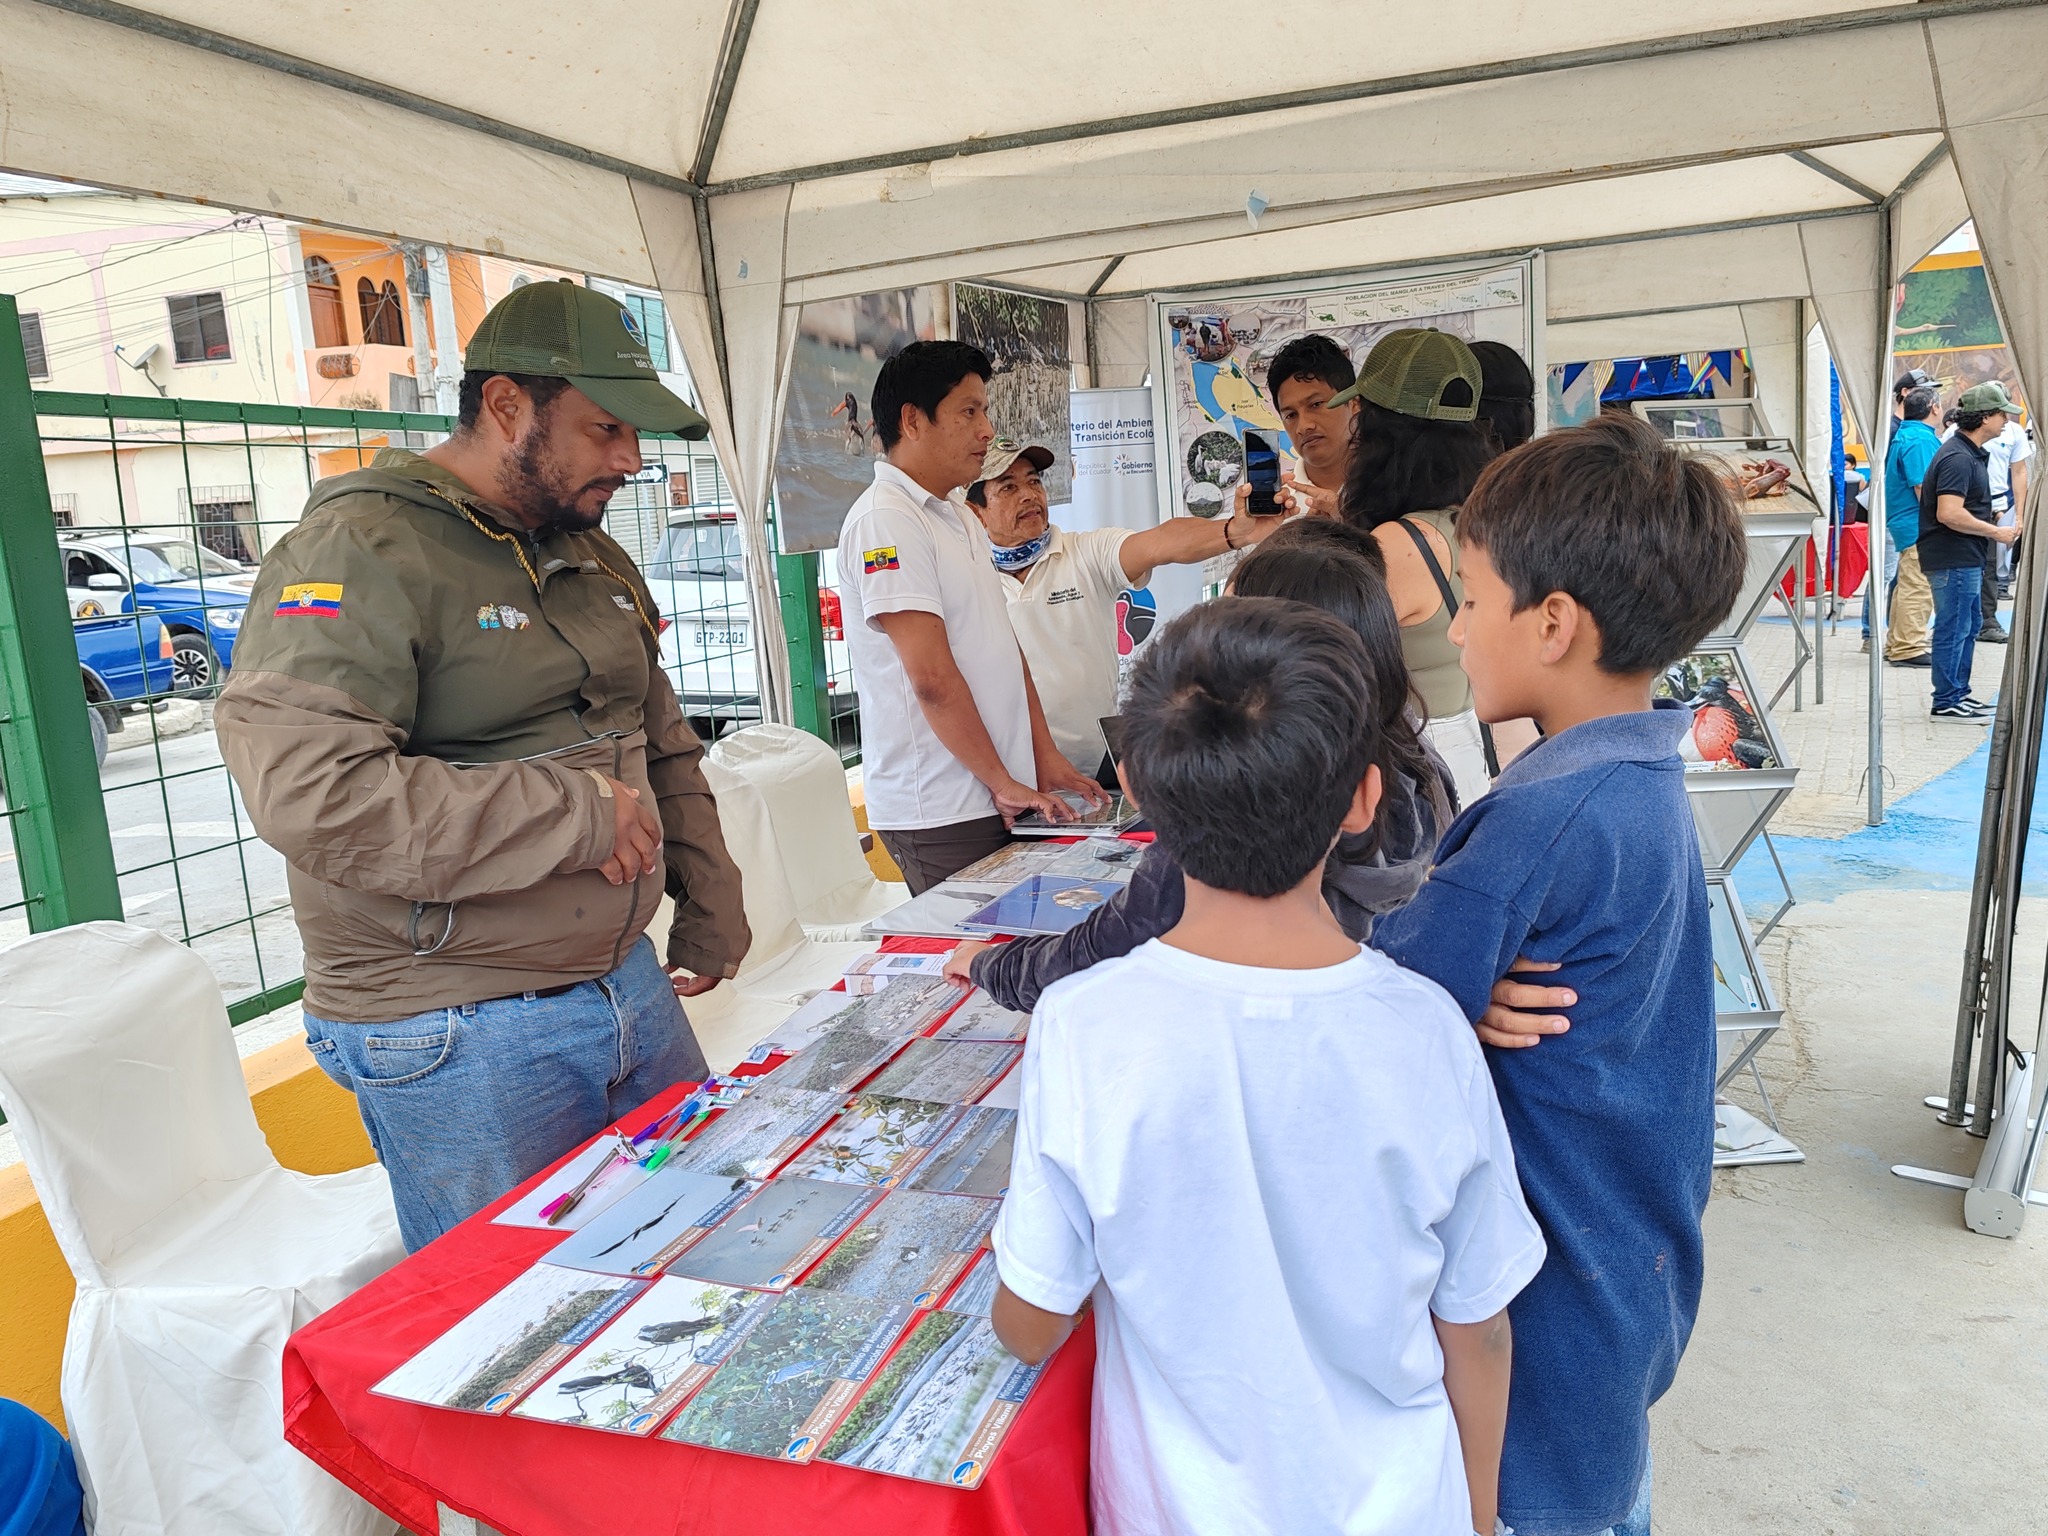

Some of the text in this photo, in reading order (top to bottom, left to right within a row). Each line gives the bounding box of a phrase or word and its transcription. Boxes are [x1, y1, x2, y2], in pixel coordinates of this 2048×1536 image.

[1075, 430, 1125, 442] Transición
[1098, 420, 1112, 429] del
[1121, 461, 1153, 470] Gobierno
[840, 1352, 866, 1378] Ministerio
[886, 1304, 902, 1316] Agua
[857, 1349, 882, 1375] Transición
[876, 1324, 901, 1348] Ecológica
[514, 1346, 571, 1389] Playas Villamil
[656, 1365, 709, 1412] Playas Villamil
[998, 1374, 1021, 1397] Ministerio
[1014, 1372, 1037, 1396] Transición
[811, 1381, 855, 1435] Playas Villamil
[974, 1403, 1014, 1459] Playas Villamil
